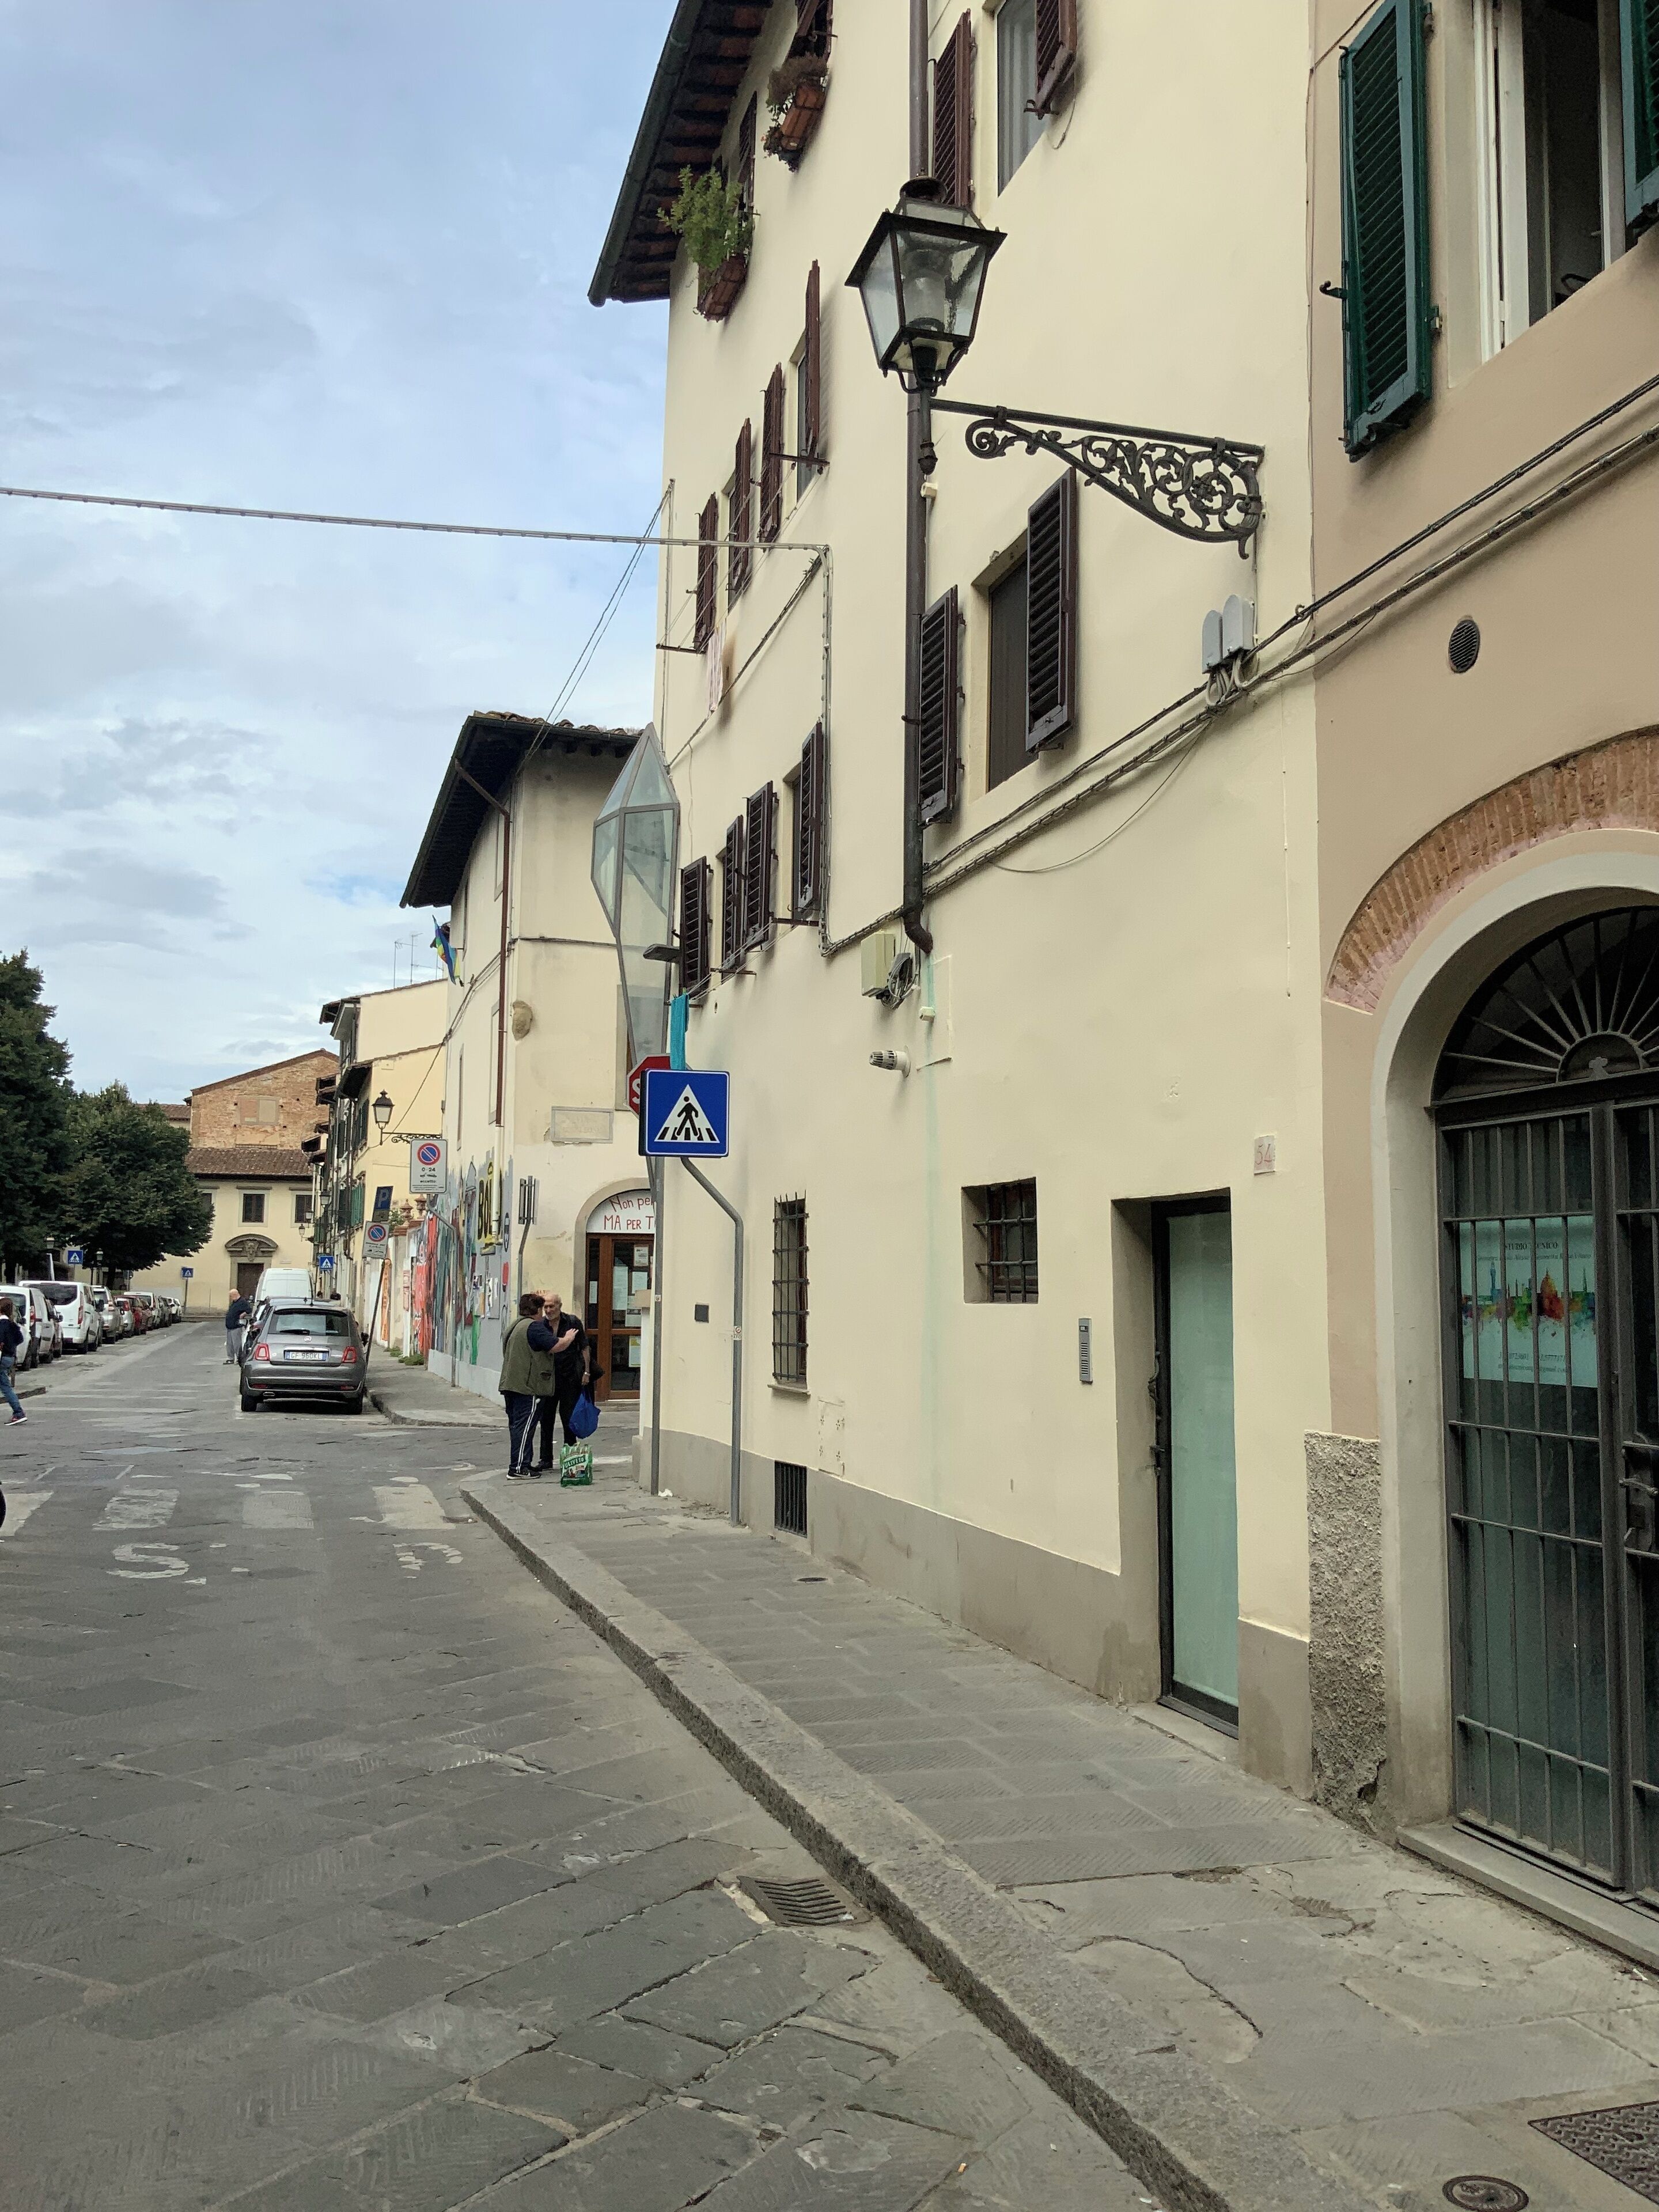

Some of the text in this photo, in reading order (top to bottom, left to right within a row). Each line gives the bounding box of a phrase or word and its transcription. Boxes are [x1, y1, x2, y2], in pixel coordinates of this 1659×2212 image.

[378, 1188, 389, 1209] P
[609, 1195, 634, 1212] Non
[604, 1215, 621, 1230] MA
[626, 1219, 641, 1230] PER
